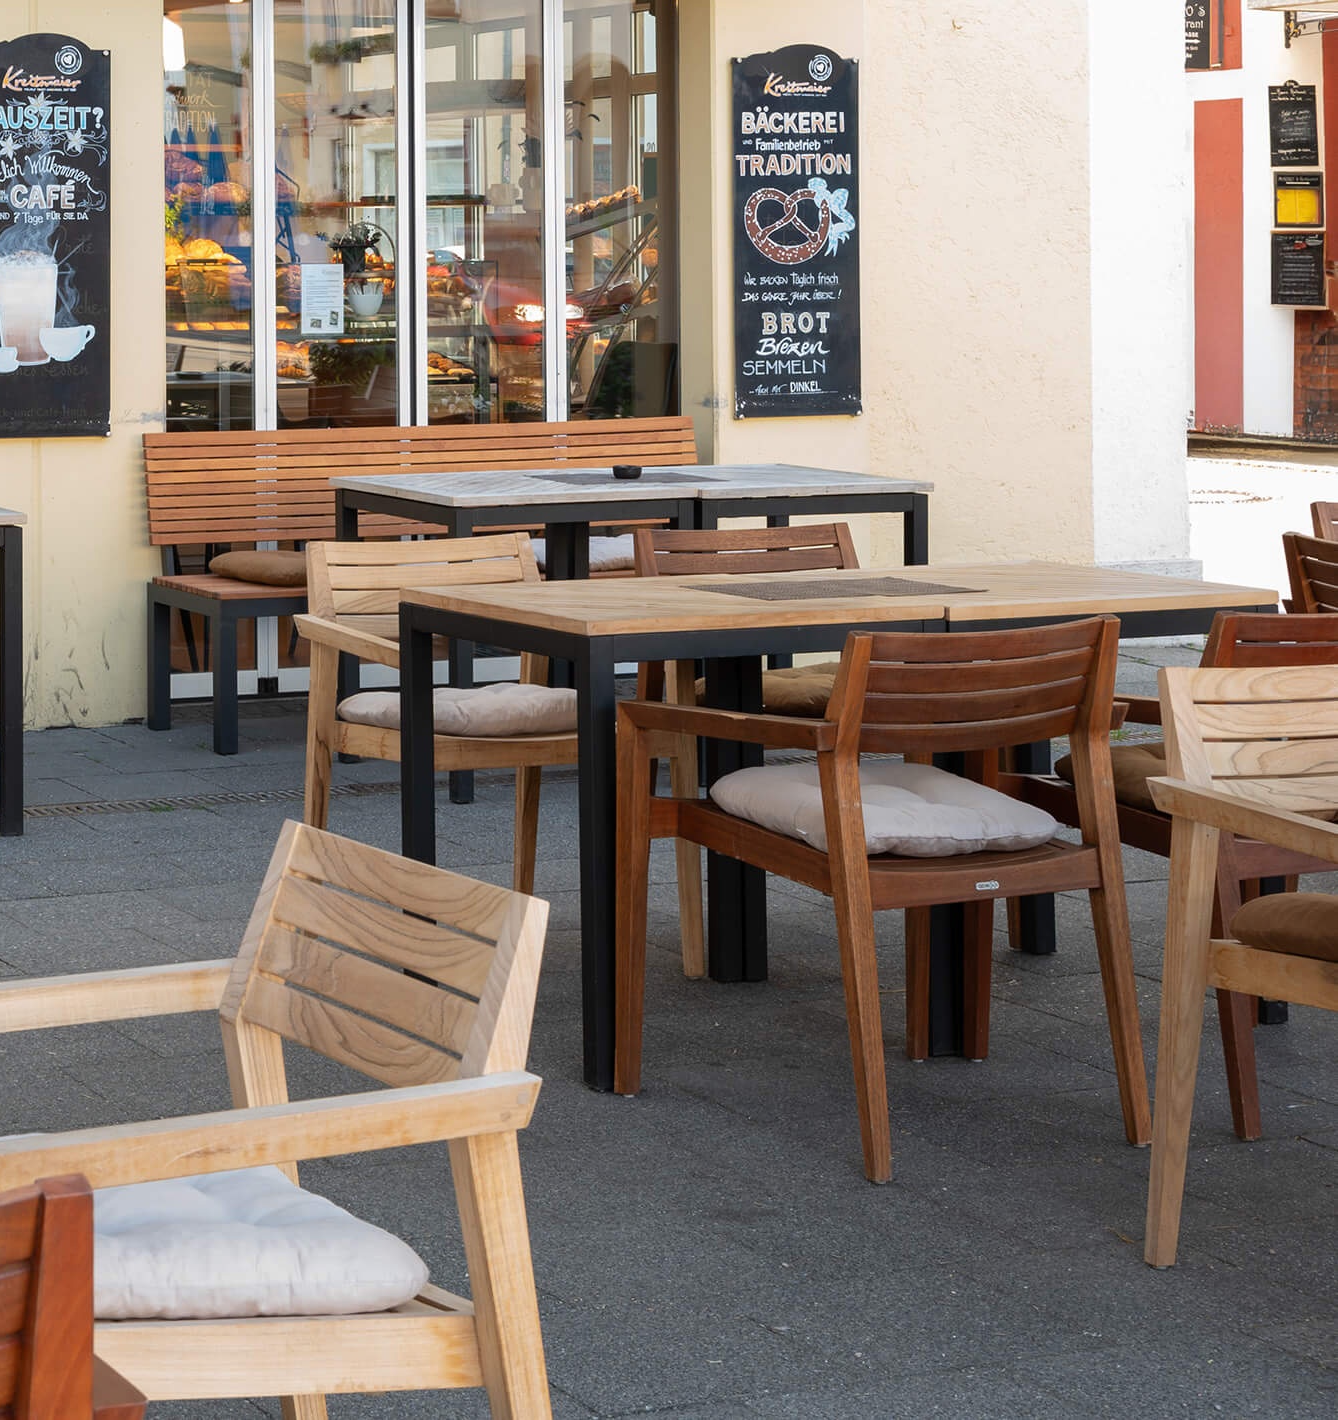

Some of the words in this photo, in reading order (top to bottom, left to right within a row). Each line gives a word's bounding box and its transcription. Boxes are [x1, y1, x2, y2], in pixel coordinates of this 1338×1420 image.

[2, 65, 82, 91] Kreitmaier
[763, 72, 832, 97] Kreitmaier
[741, 105, 845, 135] BÄCKEREI
[755, 138, 821, 151] Familienbetrieb
[25, 150, 100, 194] Willkommen
[735, 153, 852, 177] TRADITION
[10, 180, 76, 209] CAFÉ
[21, 212, 44, 226] Tage
[45, 211, 61, 220] FÜR
[761, 311, 830, 335] BROT
[755, 337, 830, 357] Brezen
[742, 359, 826, 376] SEMMELN
[790, 380, 822, 393] DINKEL
